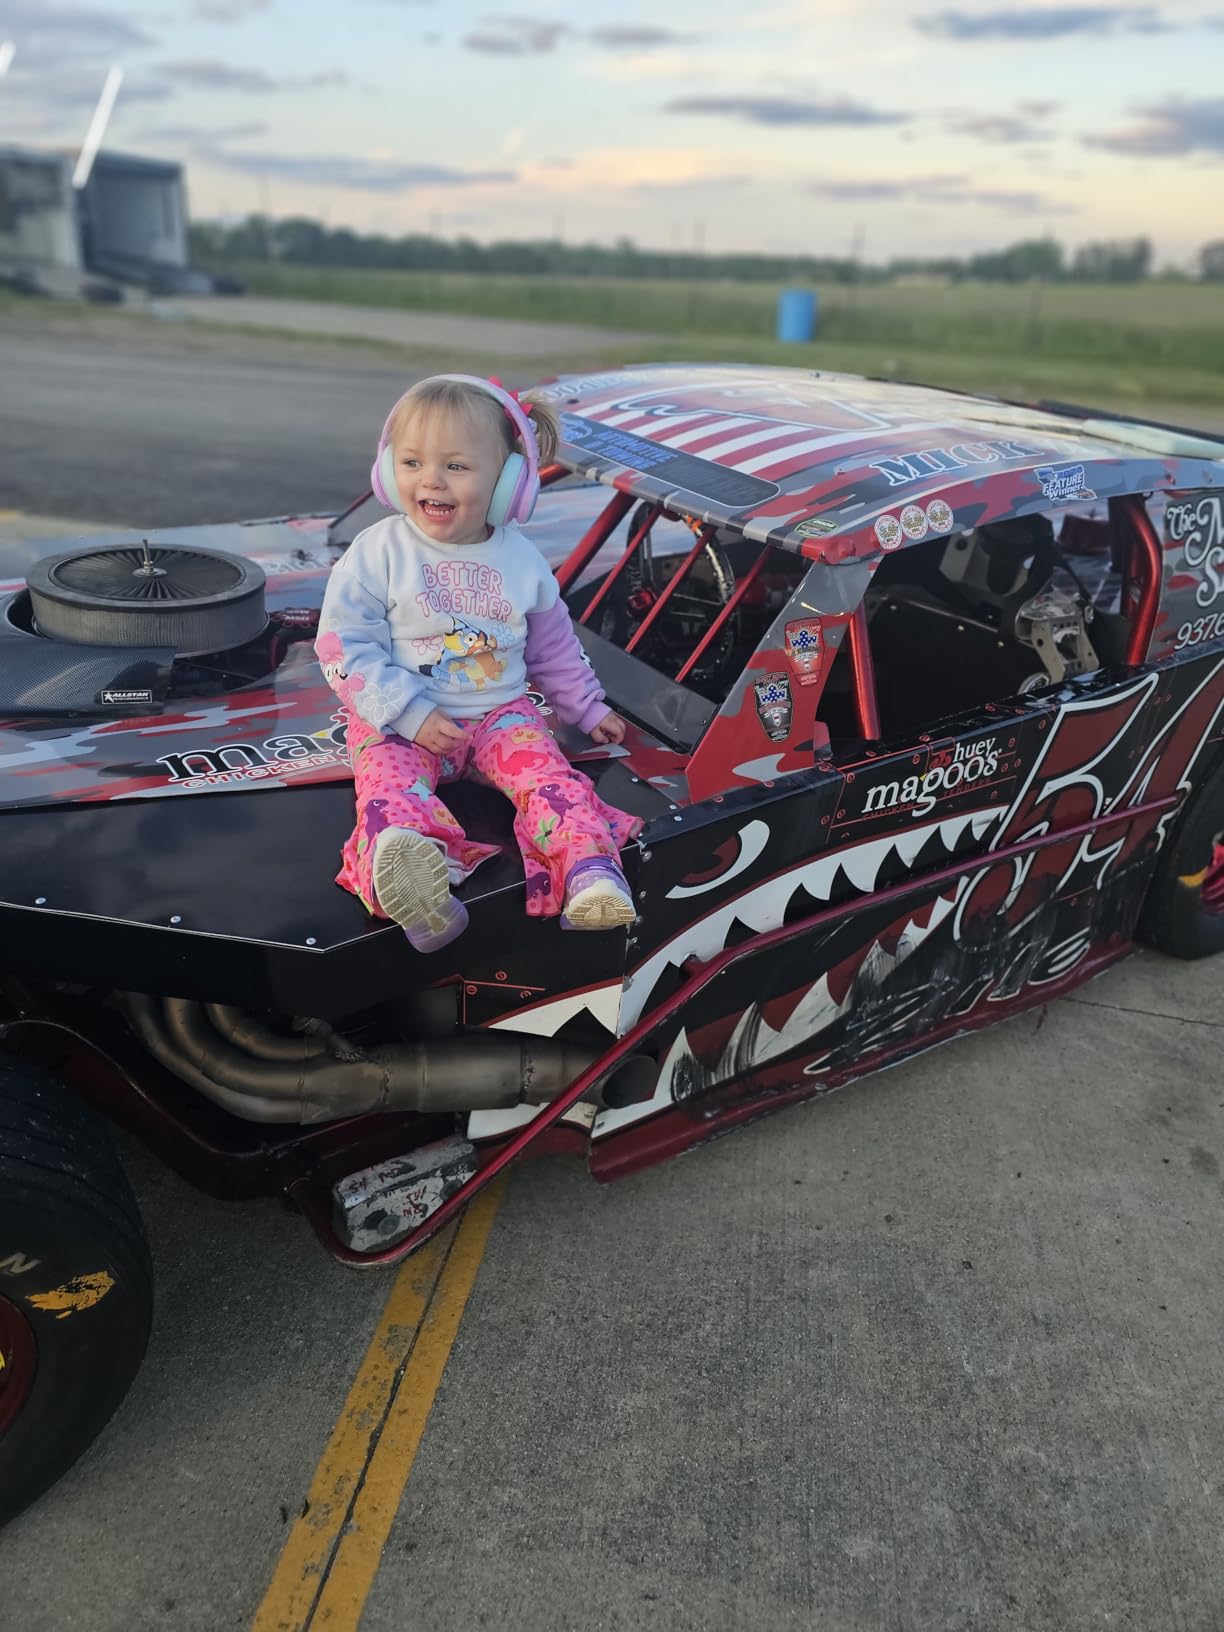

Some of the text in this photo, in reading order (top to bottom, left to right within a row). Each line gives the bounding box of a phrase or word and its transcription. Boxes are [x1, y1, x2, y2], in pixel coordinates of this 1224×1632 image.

[869, 440, 1045, 486] MICK
[1043, 473, 1084, 494] FEATURE
[1166, 502, 1197, 540] The
[421, 560, 503, 596] BETTER
[415, 587, 513, 623] TOGETHER
[156, 722, 348, 783] ma
[952, 736, 996, 763] huey
[183, 754, 338, 789] CHICKEN
[861, 750, 999, 818] magoos
[862, 801, 915, 820] CHICKEN
